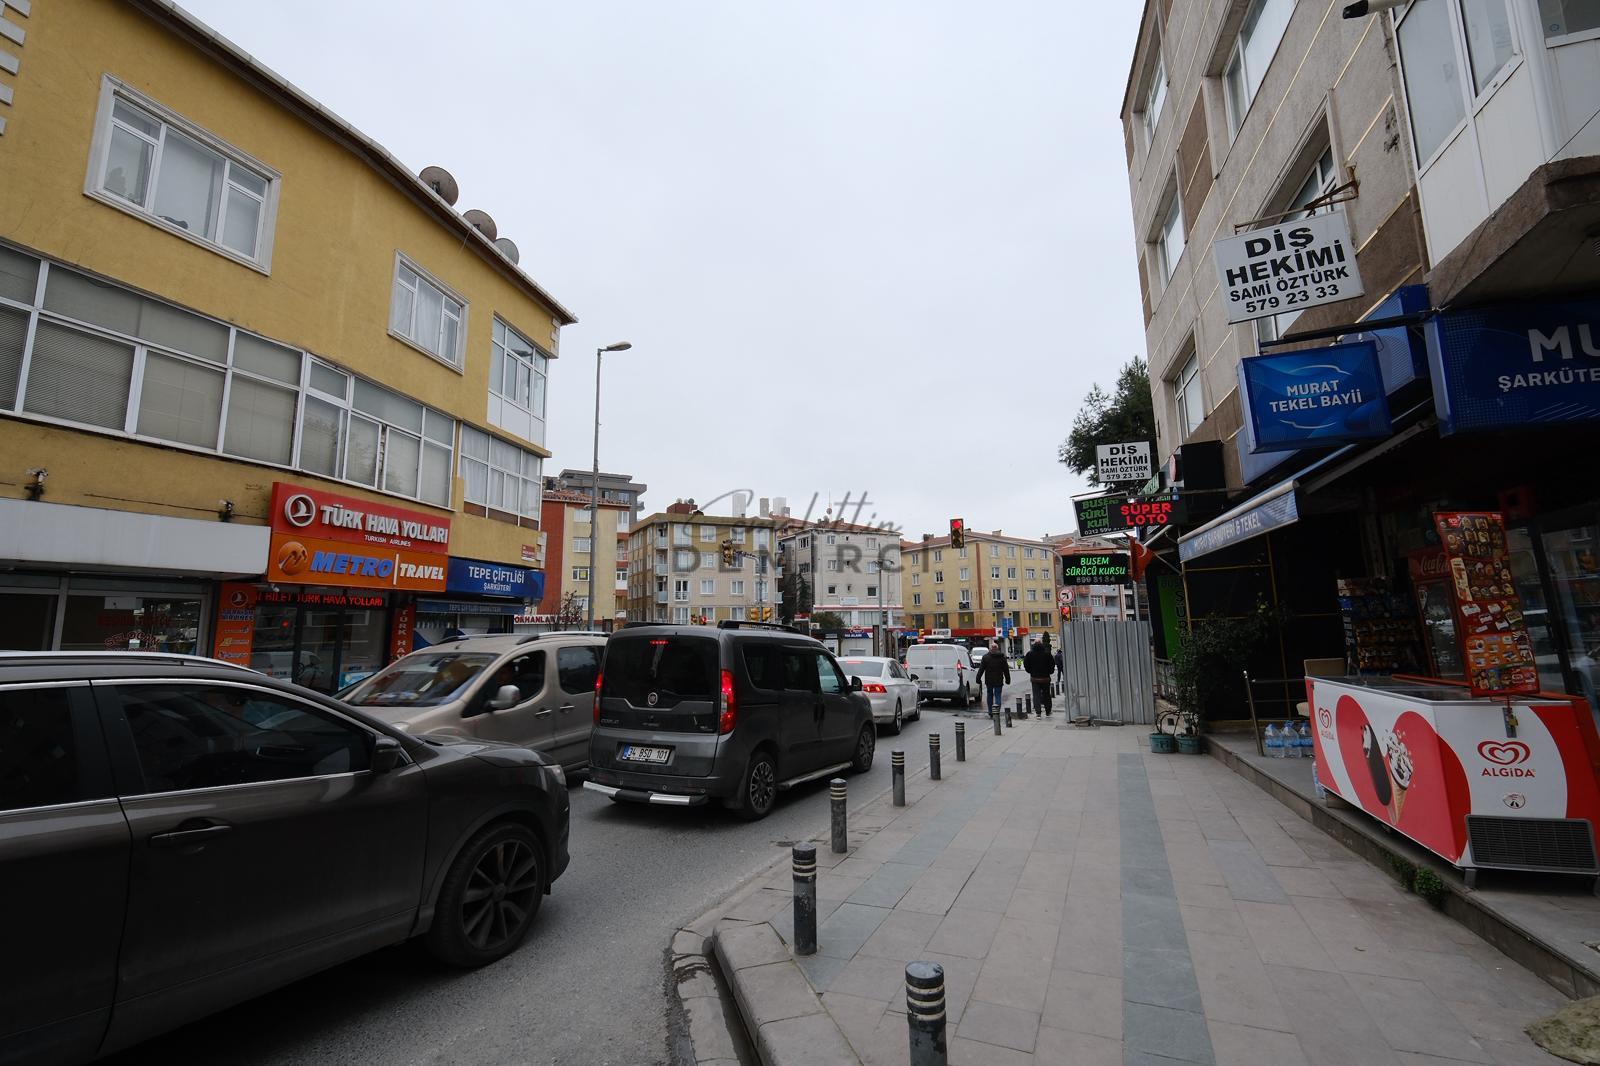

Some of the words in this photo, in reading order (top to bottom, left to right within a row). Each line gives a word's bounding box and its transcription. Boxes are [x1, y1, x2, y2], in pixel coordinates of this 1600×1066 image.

[1245, 227, 1314, 258] DİŞ
[1226, 239, 1346, 287] HEKİMİ
[1230, 280, 1272, 302] SAMİ
[1276, 266, 1349, 292] ÖZTÜRK
[1245, 296, 1280, 313] 579
[1285, 290, 1310, 305] 23
[1315, 284, 1340, 299] 33
[1286, 379, 1339, 397] MURAT
[1269, 397, 1318, 413] TEKEL
[1320, 388, 1362, 407] BAYİİ
[1109, 444, 1137, 456] DİŞ
[1100, 453, 1148, 467] HEKİMİ
[1119, 465, 1148, 473] ÖZTÜRK
[1120, 502, 1172, 516] SÜPER
[320, 503, 364, 530] TÜRK
[365, 513, 399, 536] HAVA
[402, 521, 448, 544] YOLLARI
[1126, 513, 1168, 526] LOTO
[310, 550, 394, 578] METRO
[399, 563, 444, 581] TRAVEL
[1080, 557, 1110, 566] BUSEM
[468, 566, 492, 580] TEPE
[492, 568, 525, 584] ÇİFTLİĞİ
[1065, 566, 1097, 577] SÜRÜCÜ
[1099, 566, 1126, 575] KURSU
[483, 582, 512, 592] ŞARKÜTERİ
[656, 750, 668, 760] 101
